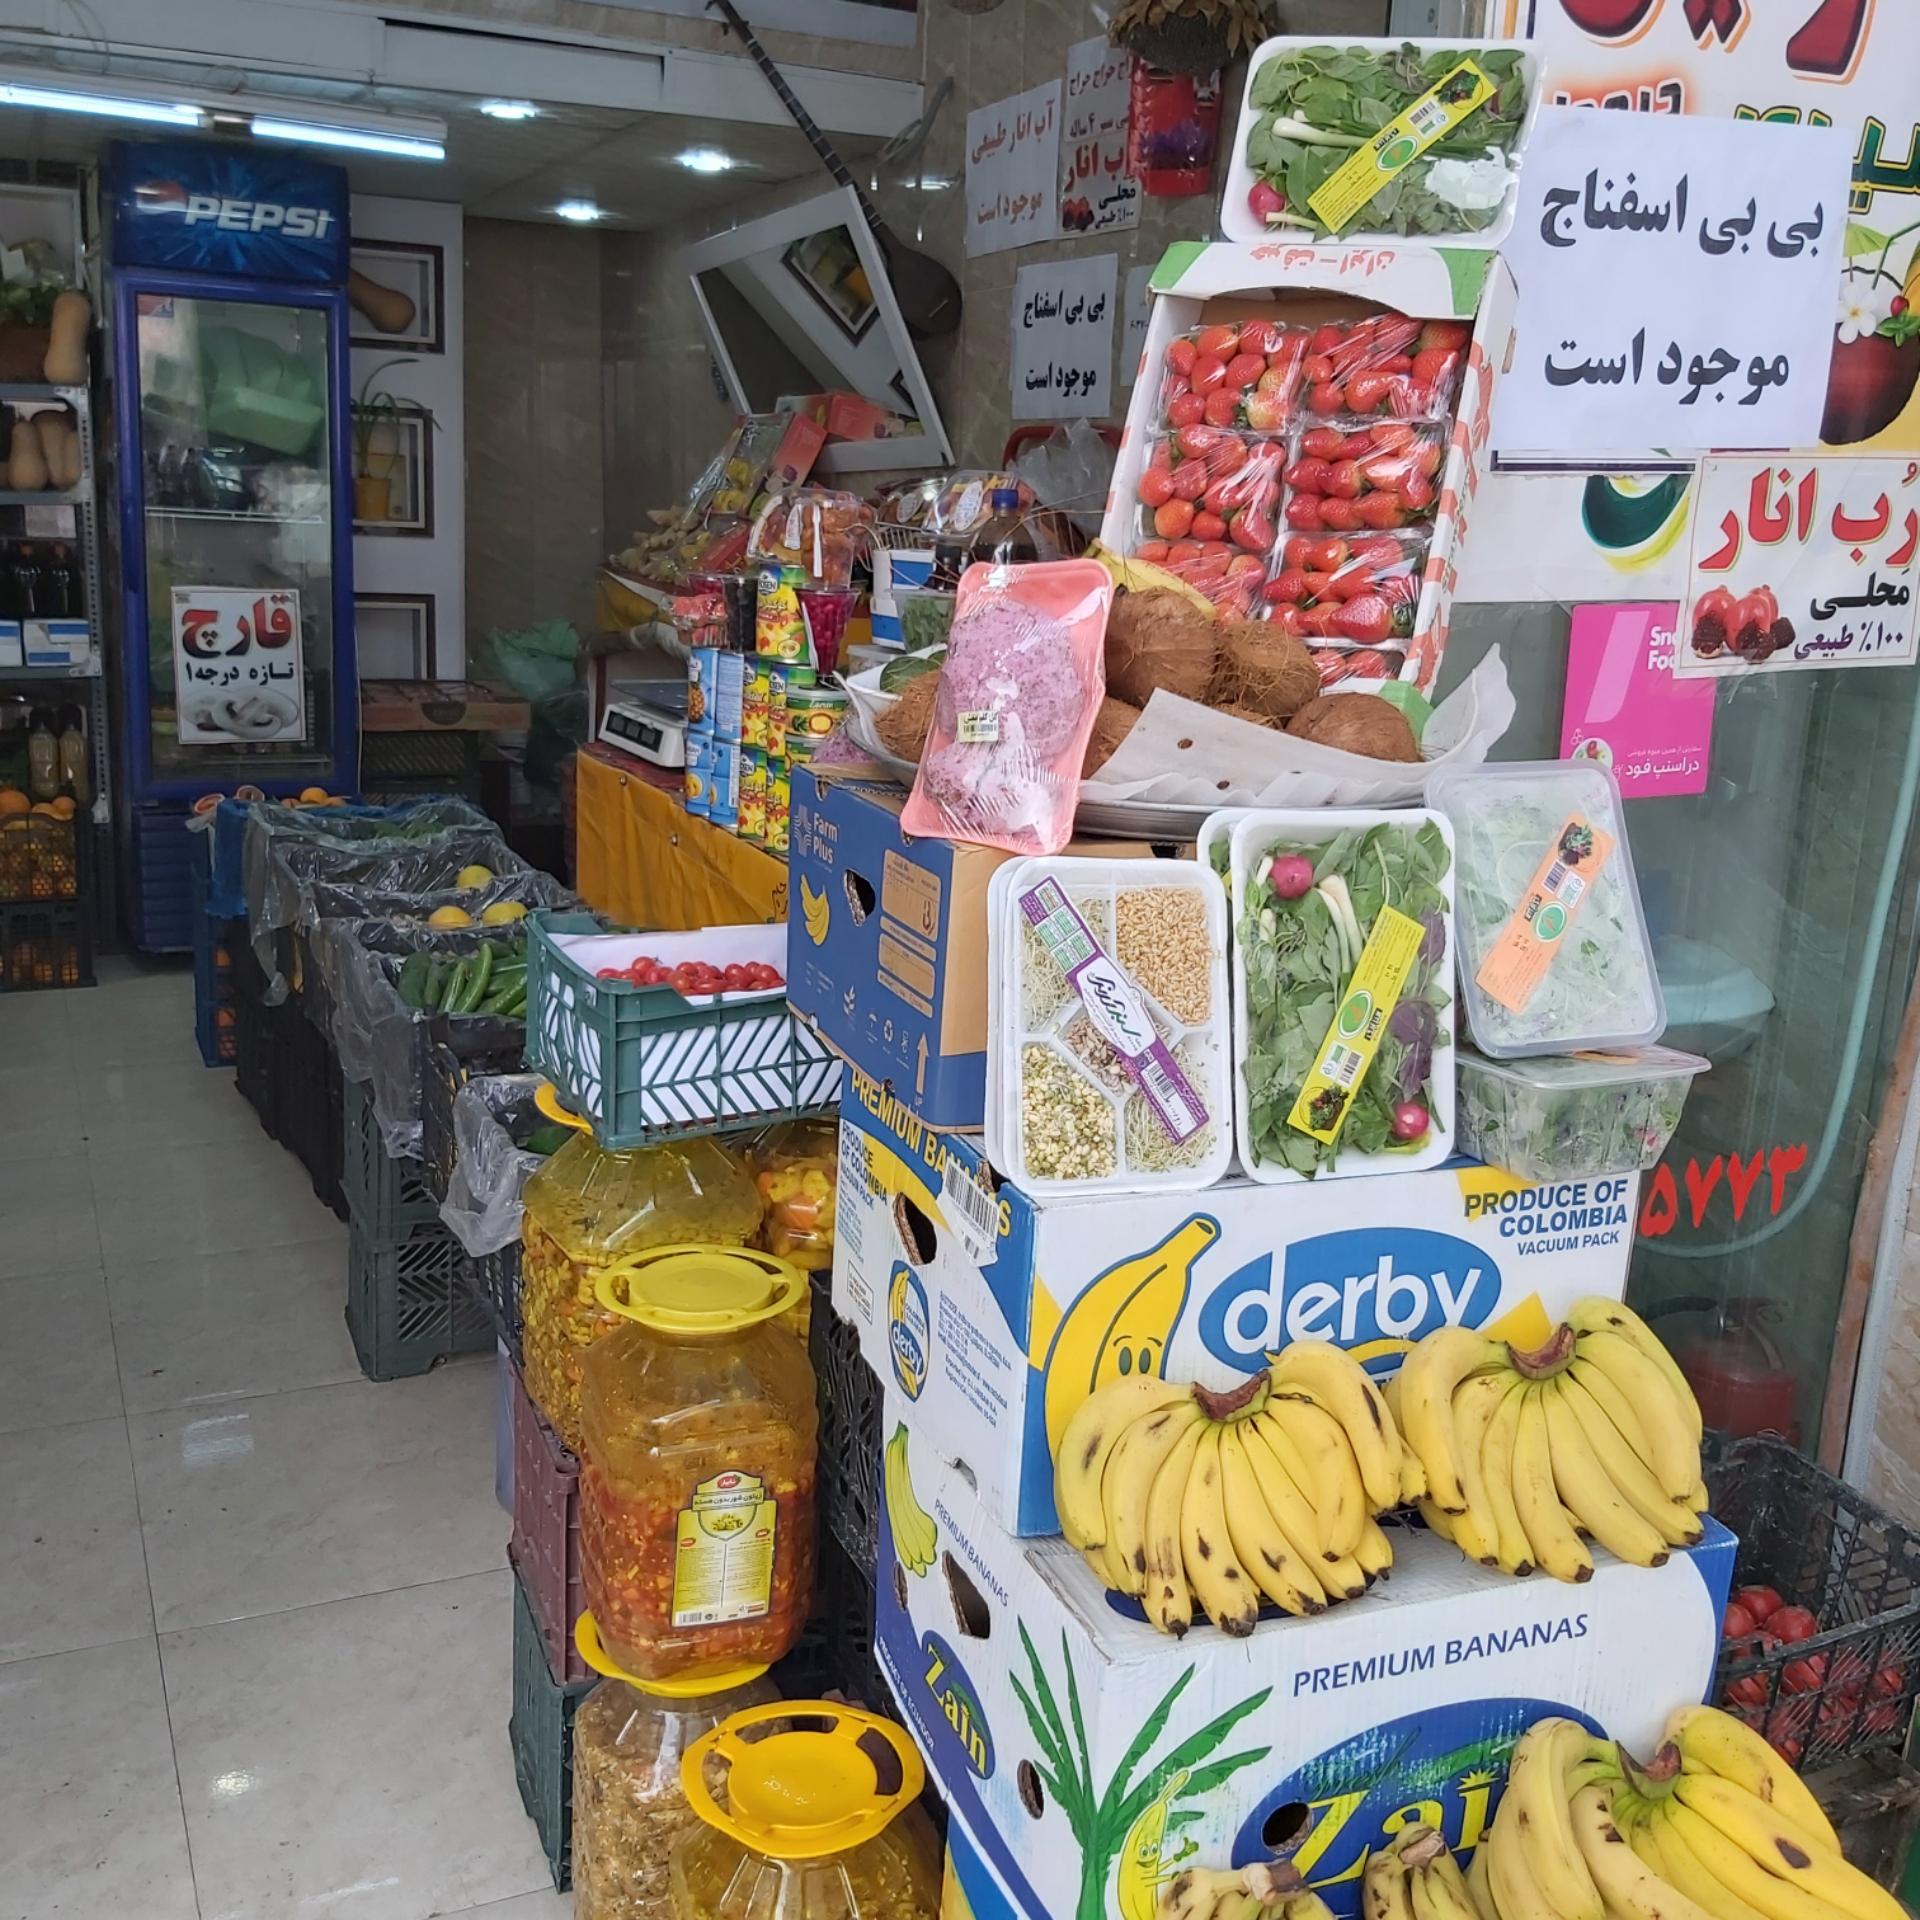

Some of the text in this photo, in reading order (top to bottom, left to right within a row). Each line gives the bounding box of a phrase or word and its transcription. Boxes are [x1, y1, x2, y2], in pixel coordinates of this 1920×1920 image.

[1009, 111, 1032, 152] انار
[1034, 99, 1055, 143] آب
[1064, 143, 1098, 192] انار
[184, 195, 330, 239] PEPSI
[1005, 192, 1043, 224] موجود
[1540, 167, 1824, 258] بی بی اسفناج
[1339, 250, 1396, 277] ایران
[1023, 290, 1105, 328] بی بی اسفناج
[1026, 361, 1096, 397] موجود است
[1545, 327, 1789, 405] موجود است
[1699, 467, 1818, 570] انار
[182, 592, 291, 659] قارچ
[1795, 625, 1853, 659] طبیعی
[249, 662, 294, 686] تازه
[1625, 757, 1700, 780] در اسنپ فود
[813, 812, 838, 842] Farm
[813, 835, 834, 864] Plus
[852, 1067, 922, 1154] PREMIUM
[842, 1122, 873, 1168] PRODUCE
[850, 1149, 888, 1206] COLOMBIA
[1464, 1180, 1628, 1218] PRODUCE OF
[1499, 1204, 1628, 1238] COLOMBIA
[1517, 1232, 1619, 1256] VACUUM PACK
[1223, 1244, 1482, 1354] derby
[893, 1321, 922, 1376] derby
[934, 1498, 1008, 1607] PREMIUM BANANAS
[1293, 1614, 1588, 1697] PREMIUM BANANAS
[924, 1643, 986, 1777] Zain
[1291, 1768, 1492, 1889] Zai
